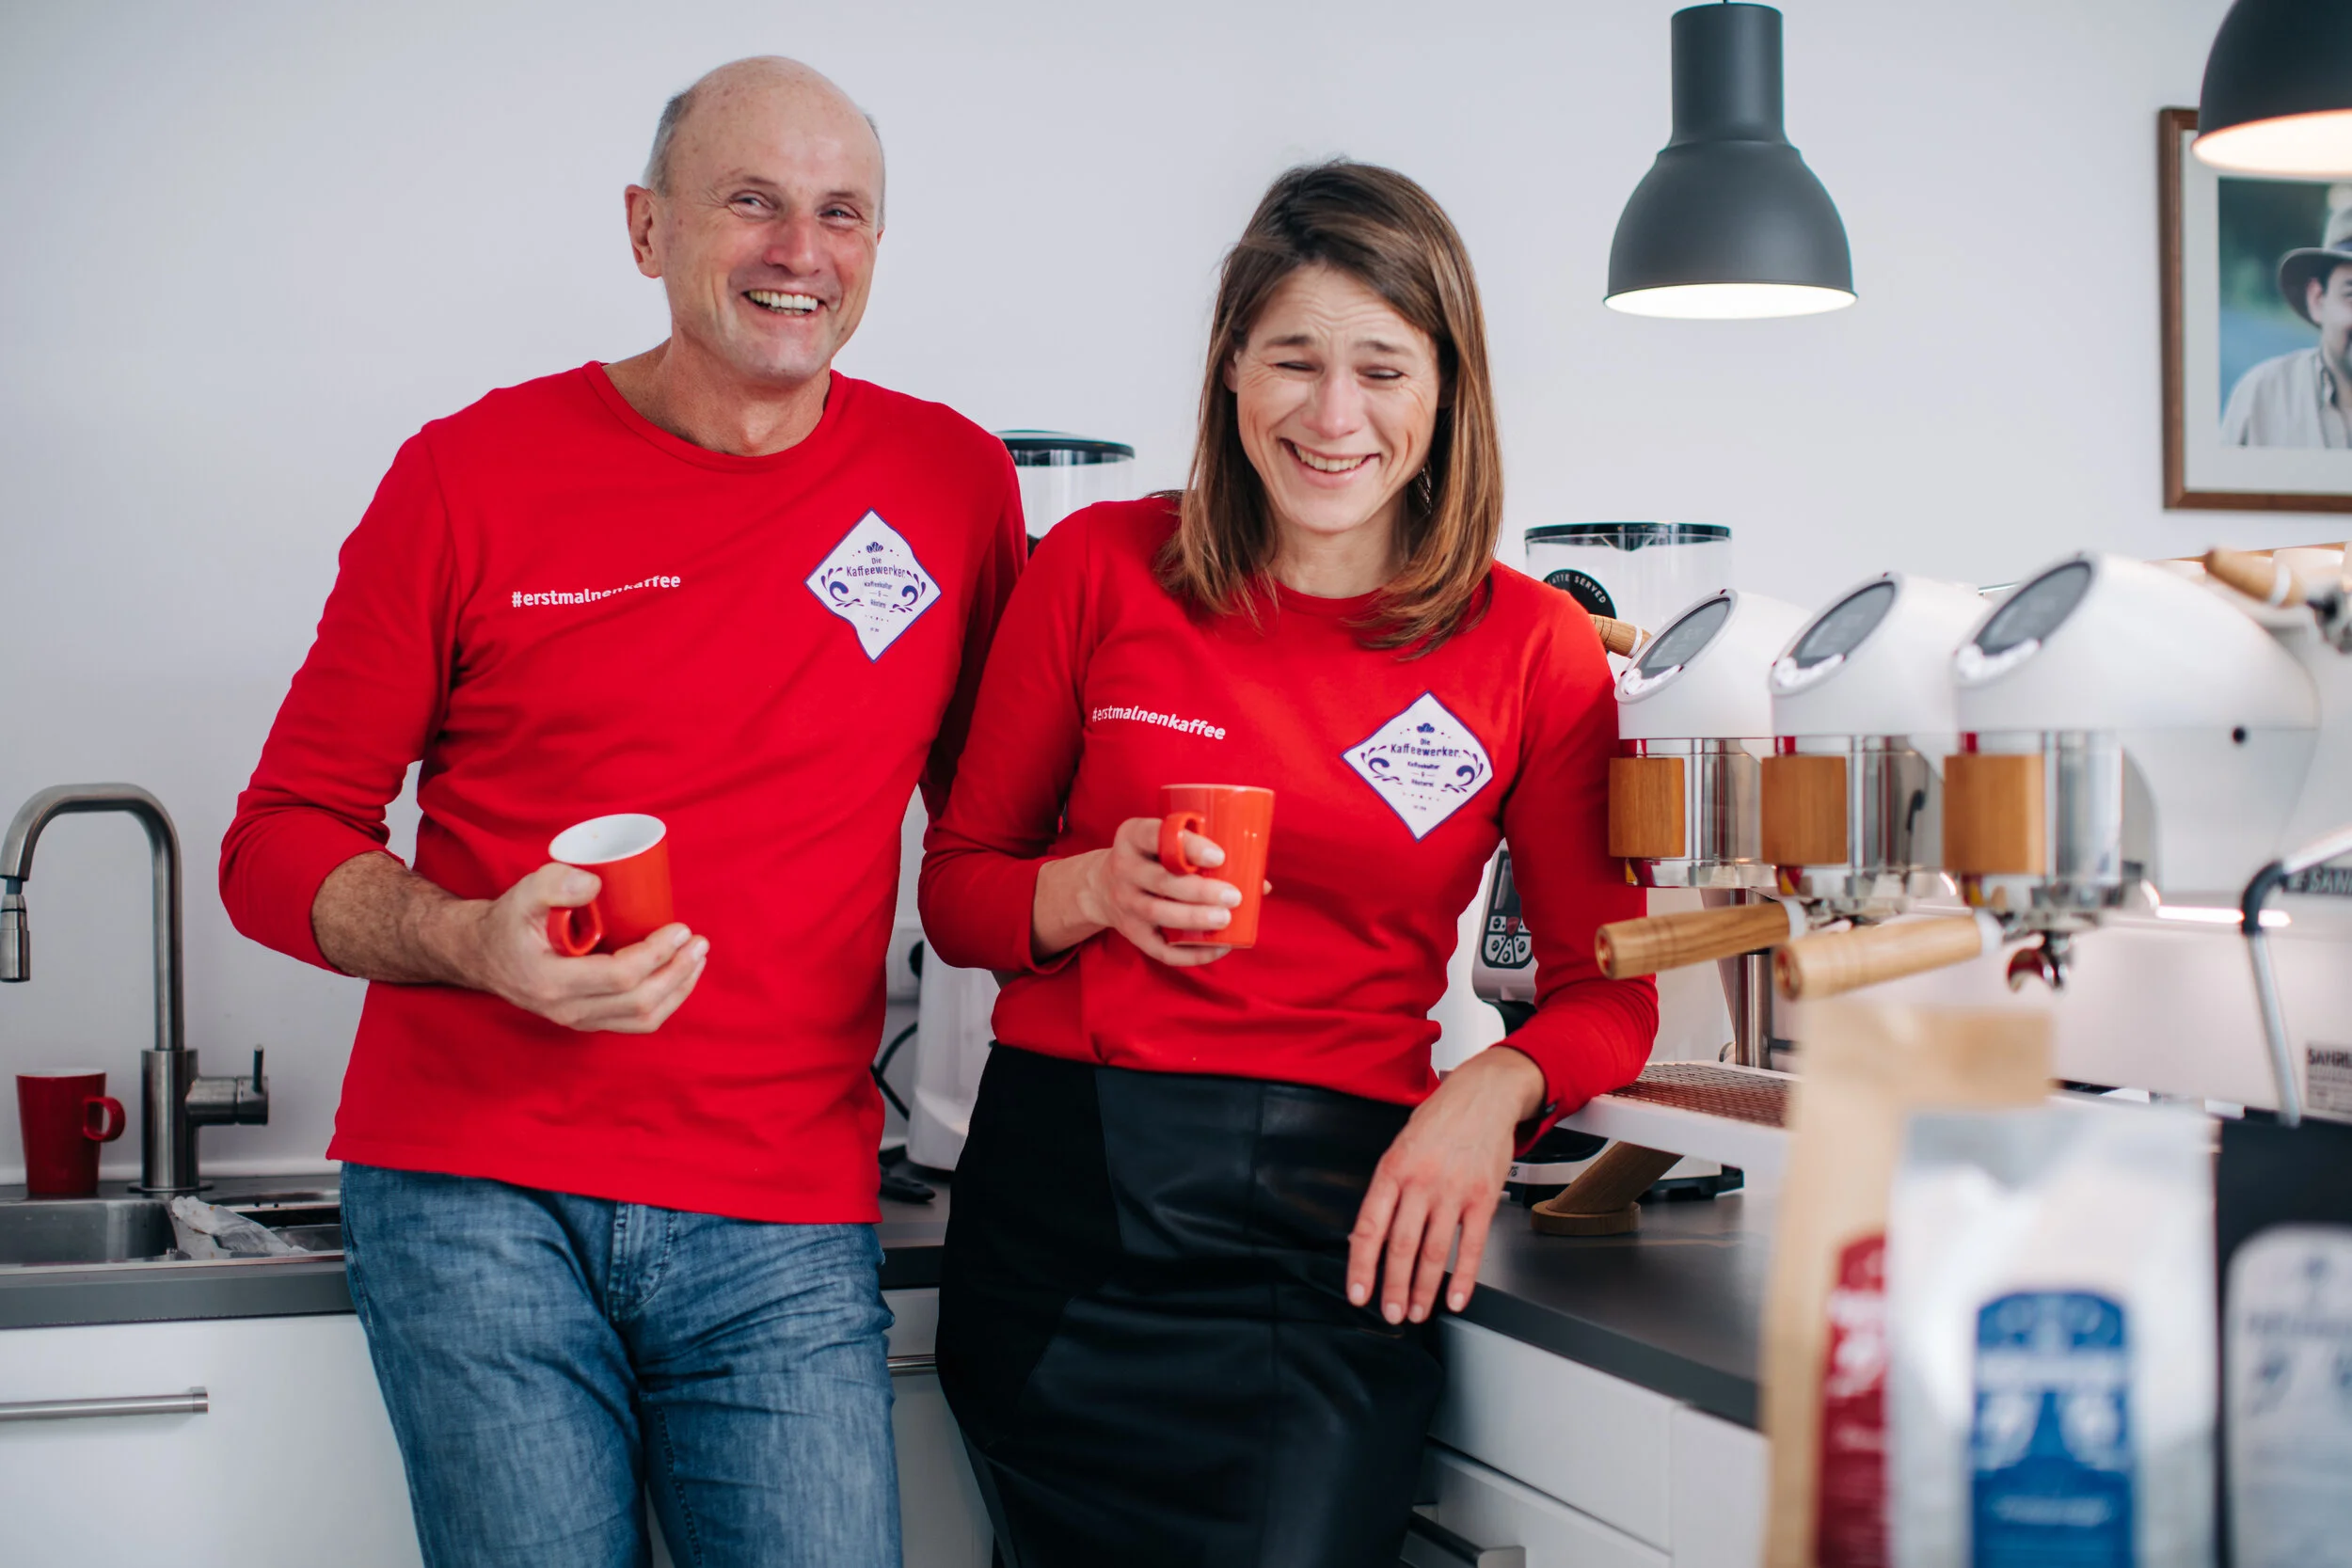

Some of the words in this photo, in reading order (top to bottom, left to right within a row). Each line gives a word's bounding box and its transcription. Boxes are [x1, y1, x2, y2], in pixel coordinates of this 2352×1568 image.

[511, 576, 681, 608] #erstmalnenkaffee
[1574, 575, 1607, 604] SERVED
[1091, 705, 1227, 740] #erstmalnenkaffee
